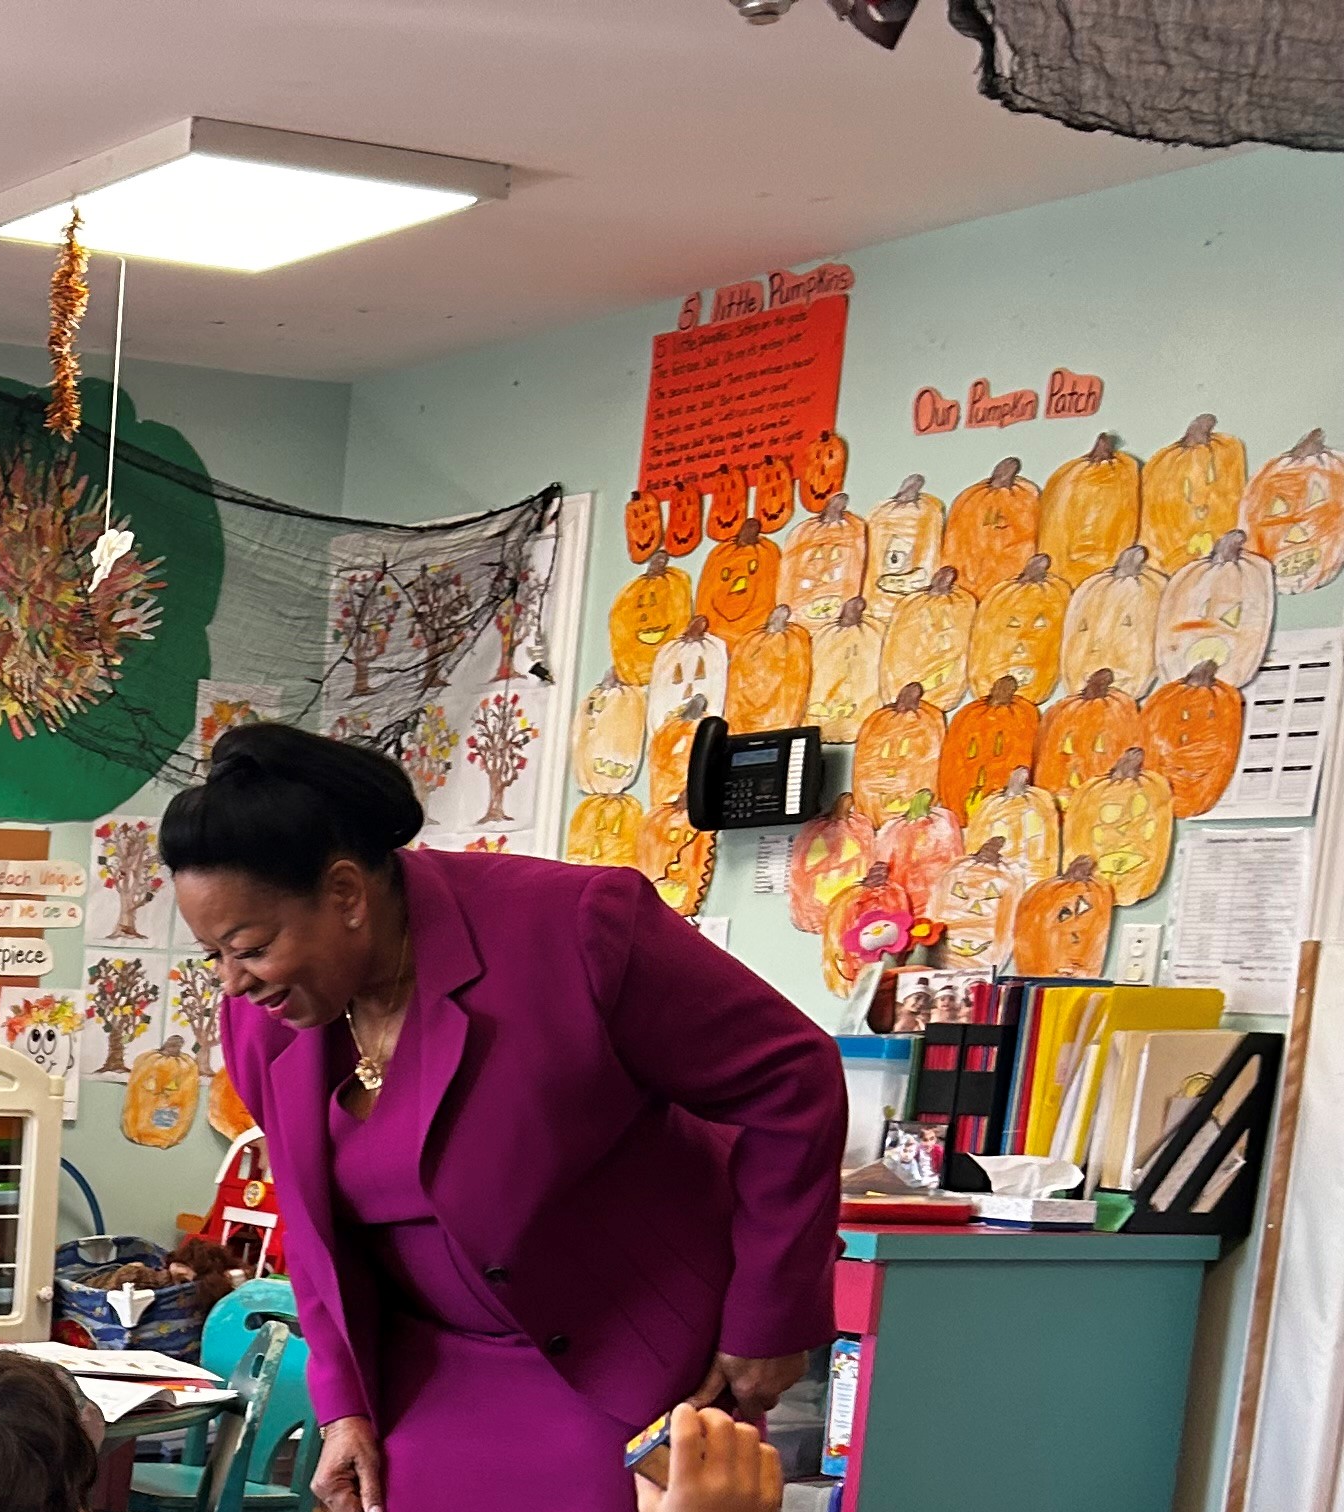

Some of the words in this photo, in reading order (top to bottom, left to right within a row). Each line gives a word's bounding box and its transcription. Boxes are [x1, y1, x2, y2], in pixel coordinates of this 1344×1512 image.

[679, 296, 696, 331] 5
[768, 270, 850, 308] Pumpkins
[916, 389, 956, 432] Our
[968, 381, 1036, 427] Pumpkin
[1046, 370, 1097, 416] Patch
[42, 906, 61, 918] are
[67, 906, 78, 919] a
